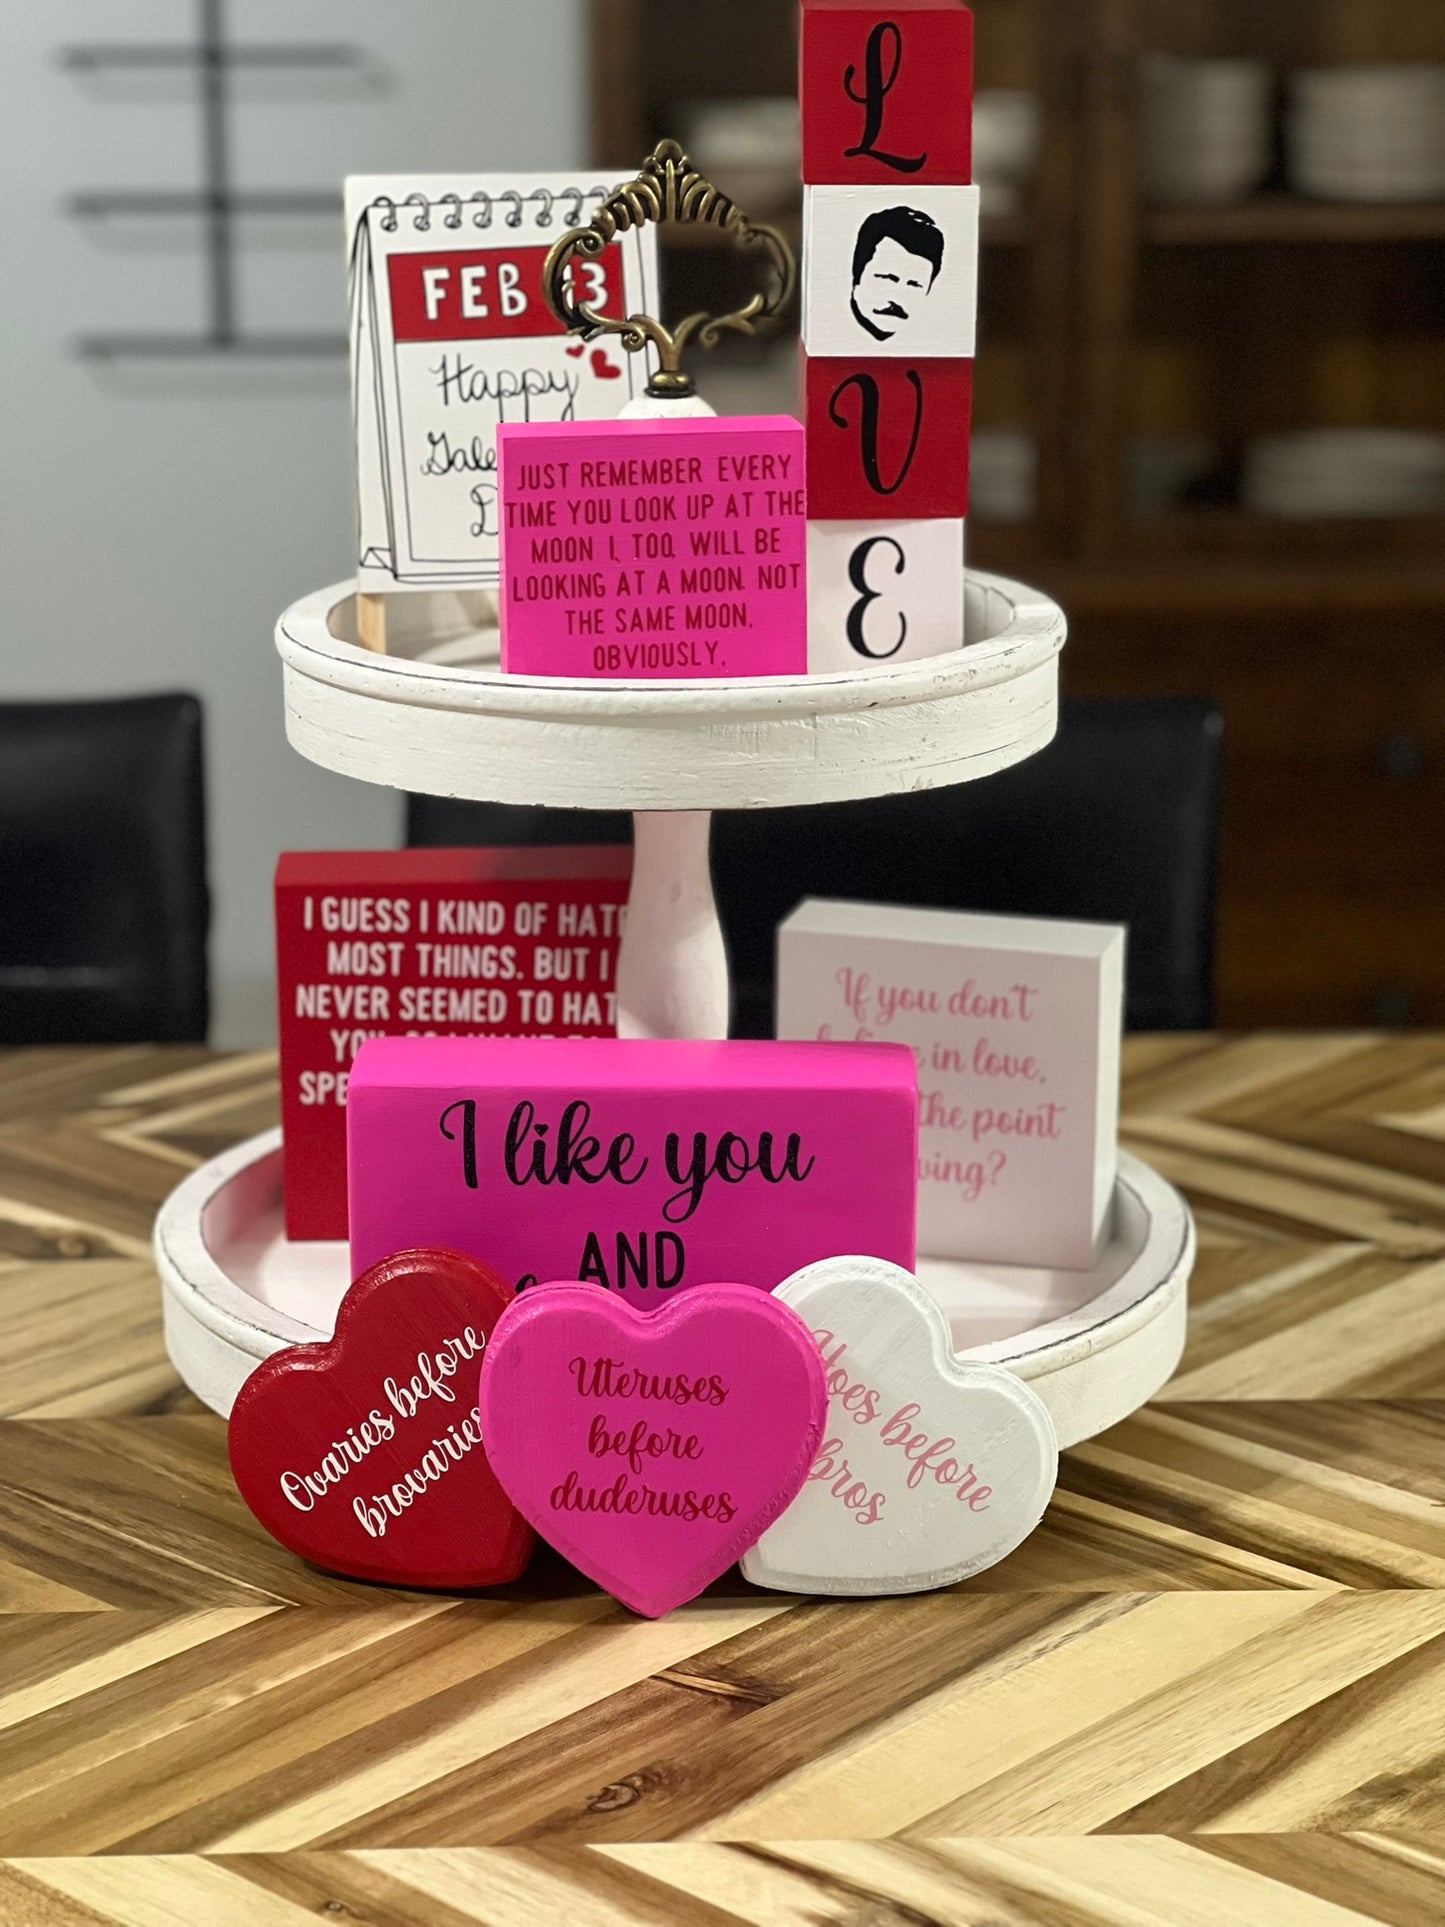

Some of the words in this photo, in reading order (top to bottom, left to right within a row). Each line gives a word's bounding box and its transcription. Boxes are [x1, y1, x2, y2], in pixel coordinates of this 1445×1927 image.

[844, 21, 927, 173] L
[422, 262, 528, 320] FEB
[428, 353, 579, 423] Happy
[829, 369, 923, 495] V
[517, 462, 569, 490] JUST
[580, 457, 702, 488] REMEMBER
[718, 454, 791, 482] EVERY
[504, 499, 557, 528] TIME
[567, 498, 611, 525] YOU
[620, 496, 676, 523] LOOK
[687, 493, 714, 519] UP
[725, 491, 753, 518] AT
[764, 489, 804, 516] THE
[531, 536, 592, 563] MOON
[632, 532, 675, 558] TOO,
[690, 530, 744, 556] WILL
[754, 527, 780, 553] BE
[513, 572, 606, 601] LOOKING
[616, 570, 645, 596] AT
[656, 569, 670, 595] A
[680, 566, 745, 594] MOON.
[758, 563, 801, 590] NOT
[846, 536, 907, 659] E
[565, 609, 604, 635] THE
[615, 605, 675, 632] SAME
[685, 603, 753, 631] MOON.
[303, 896, 313, 931] I
[321, 897, 410, 934] GUESS
[418, 899, 429, 933] I
[437, 900, 505, 935] KIND
[514, 902, 549, 936] OF
[327, 941, 404, 977] MOST
[416, 943, 525, 981] THINGS.
[533, 945, 590, 981] BUT
[600, 947, 609, 981] I
[296, 984, 390, 1020] NEVER
[399, 987, 508, 1025] SEEMED
[517, 990, 554, 1025] TO
[834, 966, 871, 1023] If
[876, 985, 942, 1026] you
[330, 1028, 386, 1063] YO
[931, 1043, 966, 1073] in
[973, 1037, 1046, 1084] love.
[972, 1101, 1066, 1142] point
[440, 1099, 478, 1189] I
[504, 1100, 649, 1185] like
[662, 1131, 815, 1223] you
[577, 1231, 685, 1290] AND
[568, 1356, 729, 1406] Uteruses
[279, 1409, 395, 1512] Ovaries
[383, 1326, 486, 1418] before
[588, 1414, 704, 1475] before
[806, 1438, 886, 1525] bros
[879, 1402, 993, 1513] before
[550, 1470, 738, 1524] duderuses
